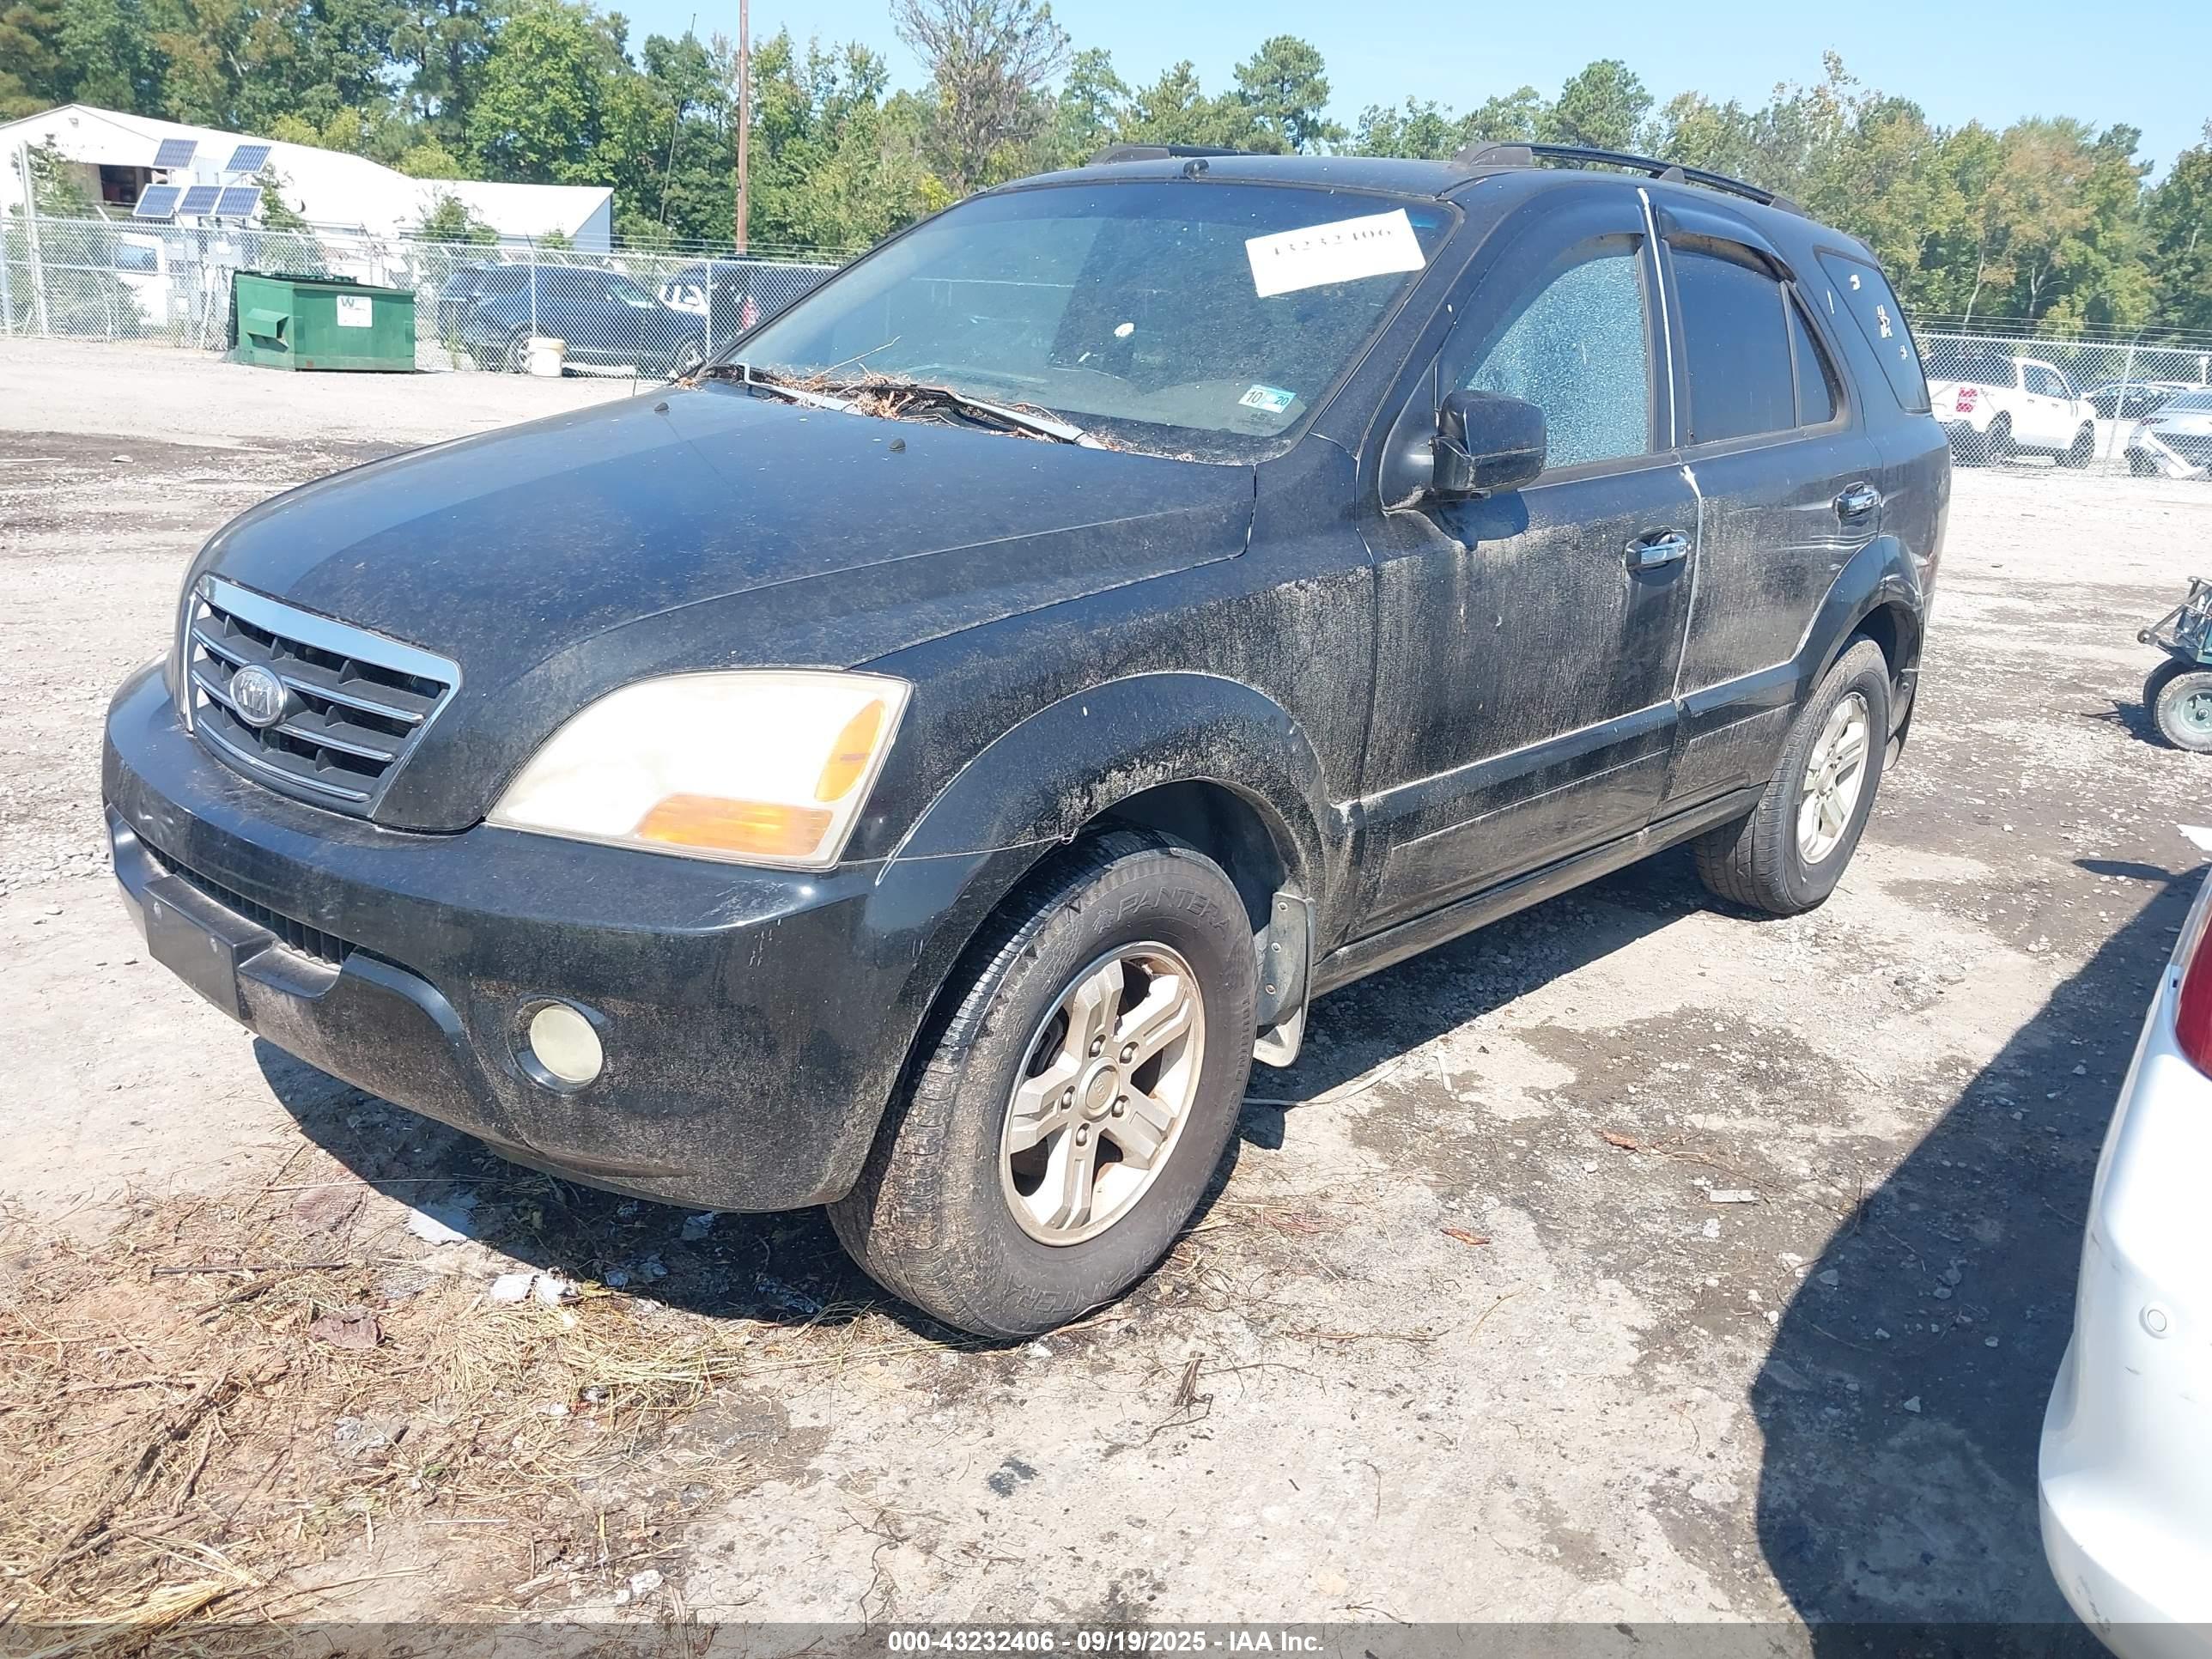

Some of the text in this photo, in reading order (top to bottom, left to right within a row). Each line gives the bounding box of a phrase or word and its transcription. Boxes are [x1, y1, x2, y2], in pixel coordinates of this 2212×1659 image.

[1246, 390, 1289, 406] 10 20
[1116, 886, 1231, 938] PANTERA
